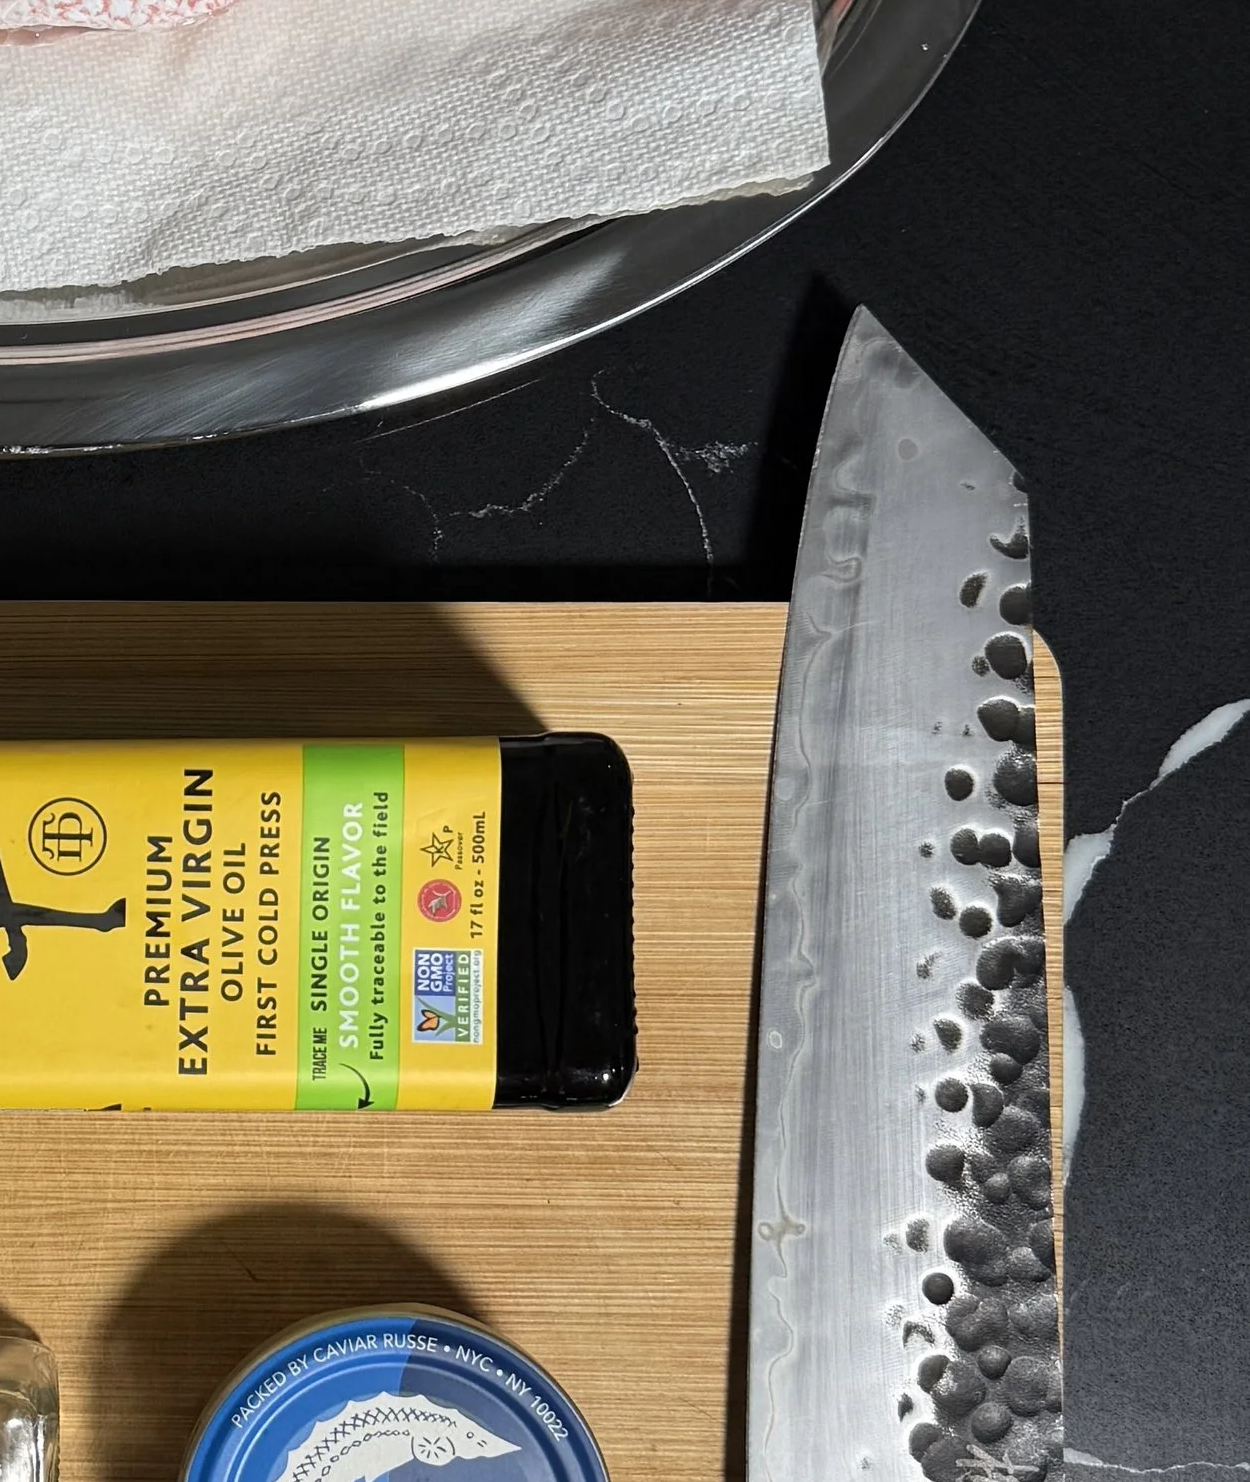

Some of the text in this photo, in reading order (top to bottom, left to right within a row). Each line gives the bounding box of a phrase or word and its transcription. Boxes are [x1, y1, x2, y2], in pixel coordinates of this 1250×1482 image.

[472, 811, 486, 863] 500mL
[144, 836, 172, 1007] PREMIUM
[179, 769, 213, 1075] EXTRA VIRGIN
[221, 843, 246, 1001] OLIVE OIL
[256, 791, 281, 1056] FIRST COLD PRESS
[311, 837, 329, 1011] SINGLE ORIGIN
[339, 803, 362, 1048] SMOOTH FLAVOR
[369, 791, 388, 1060] Fully traceable to the field
[470, 902, 484, 914] fl
[470, 919, 483, 938] 17
[473, 880, 484, 900] oz
[418, 953, 430, 991] NON
[430, 952, 443, 991] GMO
[442, 954, 456, 991] Project
[458, 955, 469, 1037] VERIFIED
[472, 950, 482, 1043] nongmoproject.org
[312, 1027, 327, 1080] TRACE ME
[231, 1333, 570, 1442] PACKED BY CAVIAR RUSSE NYC NY 10022
